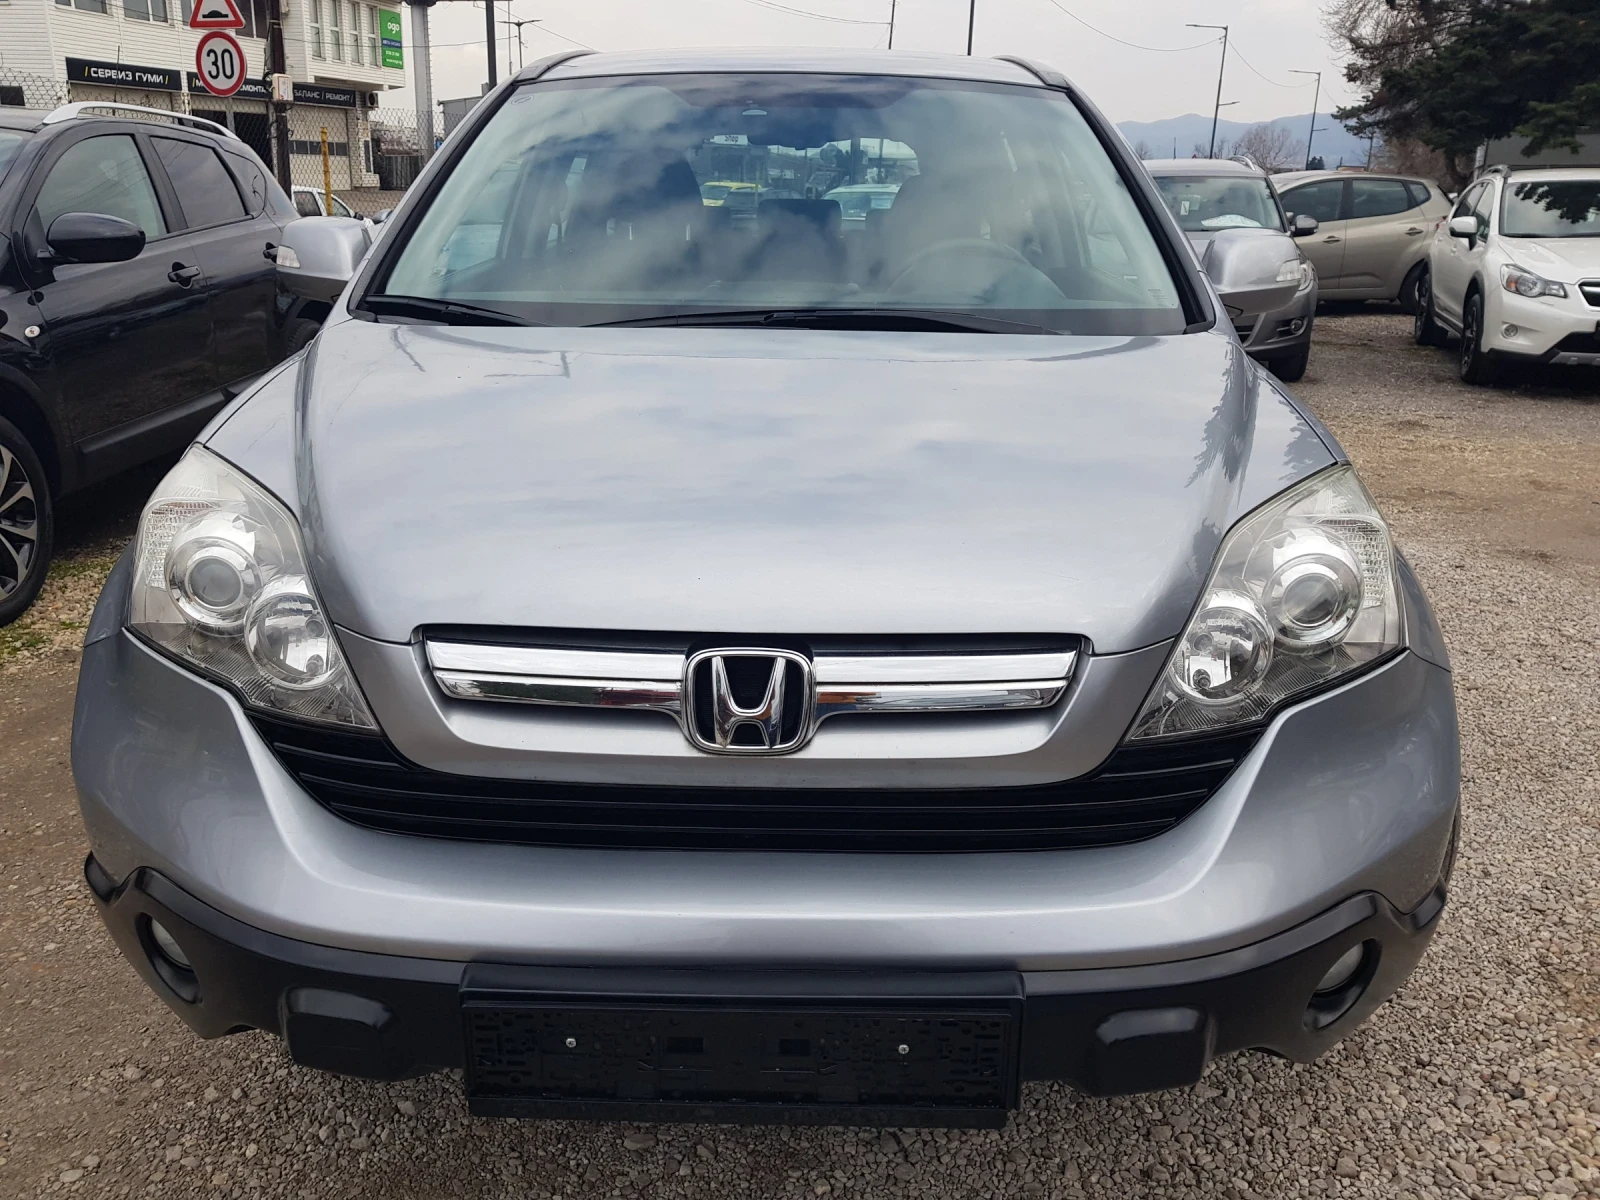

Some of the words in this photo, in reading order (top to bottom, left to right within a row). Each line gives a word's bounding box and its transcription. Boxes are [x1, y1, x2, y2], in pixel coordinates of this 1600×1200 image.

[387, 22, 400, 34] ogo
[206, 48, 235, 80] 30
[90, 67, 133, 81] СЕРВИЗ
[135, 72, 164, 84] ГУМИ
[325, 91, 350, 102] РЕМОНТ
